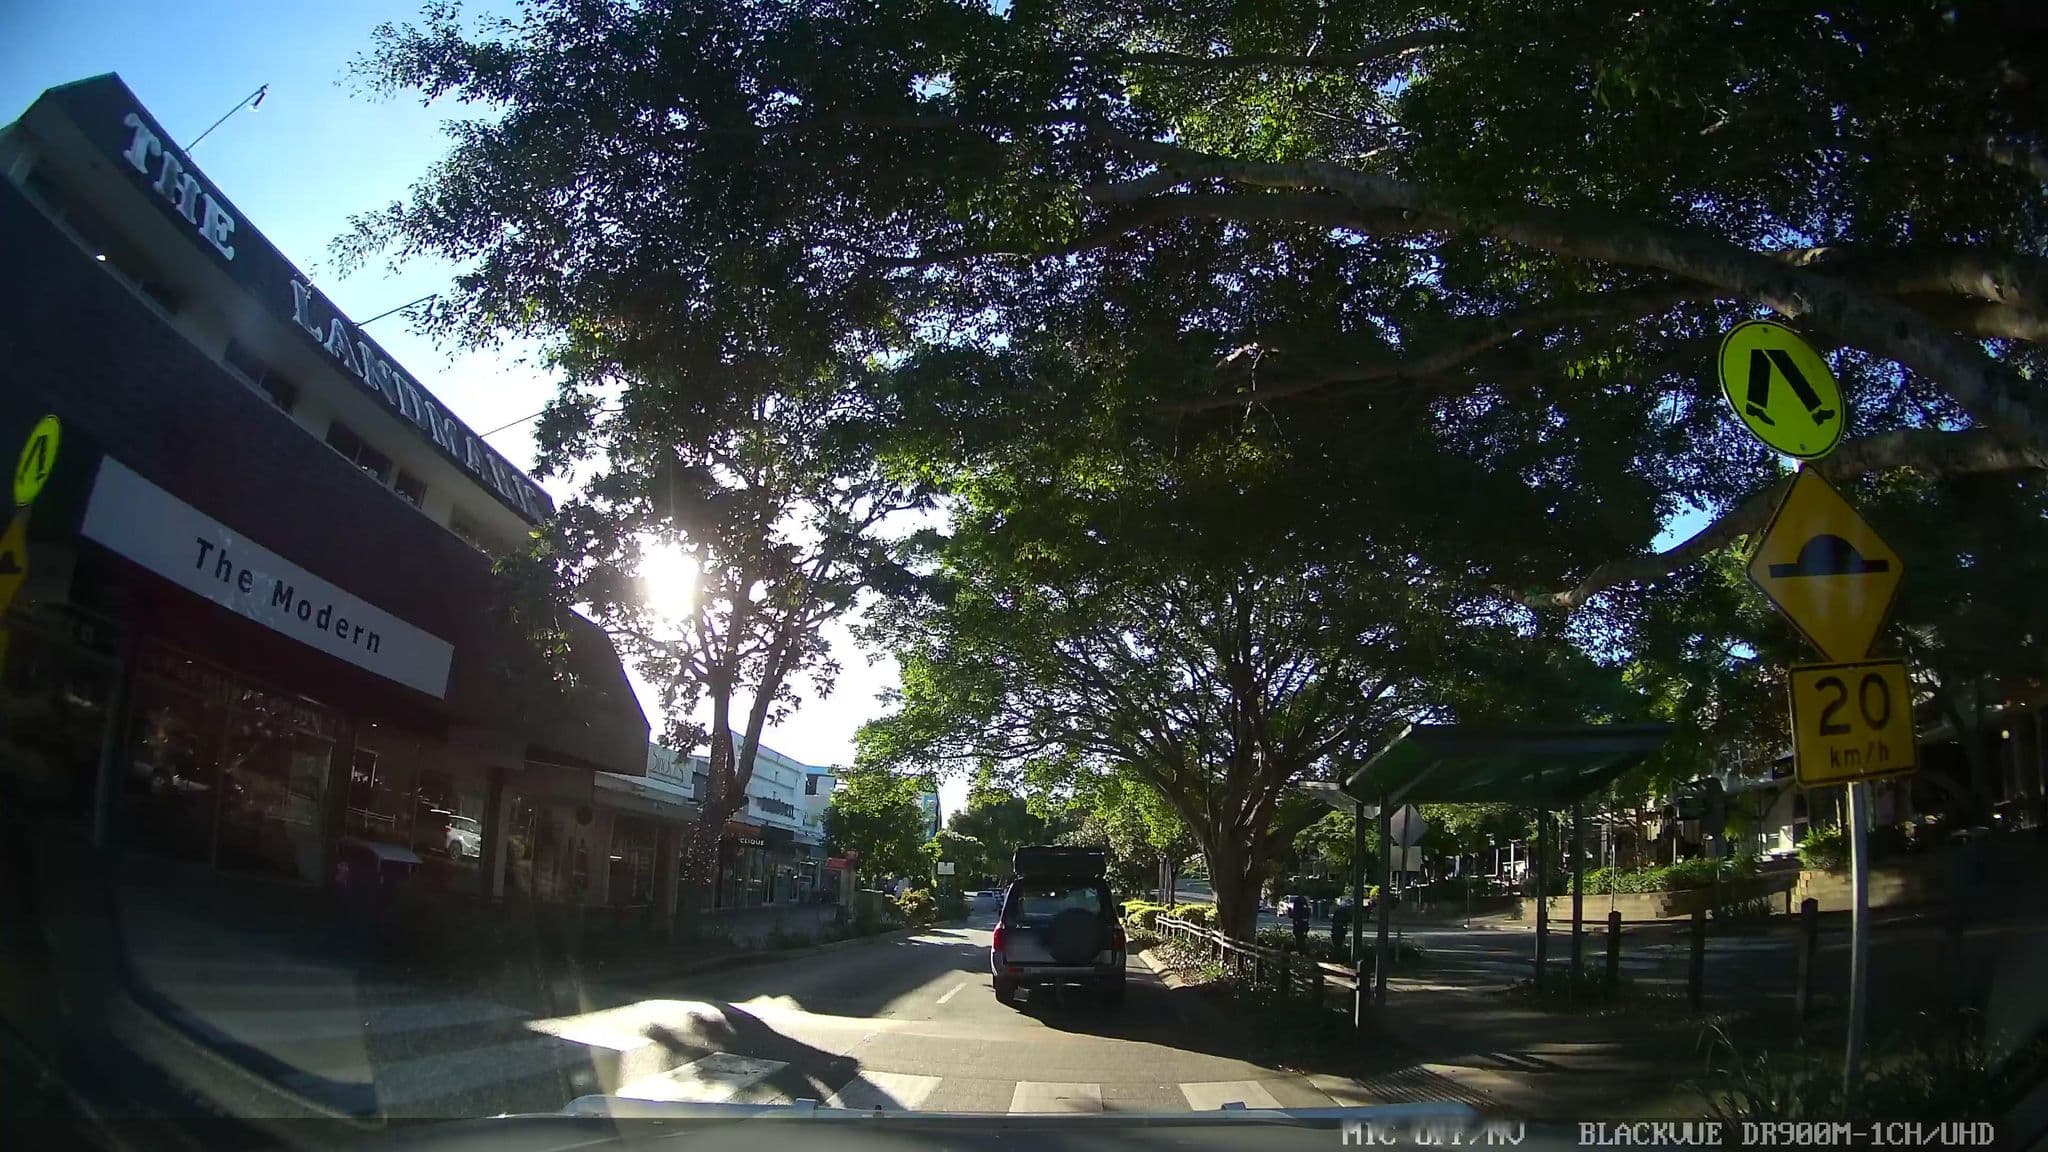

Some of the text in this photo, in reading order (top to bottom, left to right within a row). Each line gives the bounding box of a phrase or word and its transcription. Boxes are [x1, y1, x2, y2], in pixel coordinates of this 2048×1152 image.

[123, 112, 235, 260] THE
[196, 536, 381, 653] The Modern
[1815, 672, 1891, 737] 20
[1830, 740, 1889, 768] km/h
